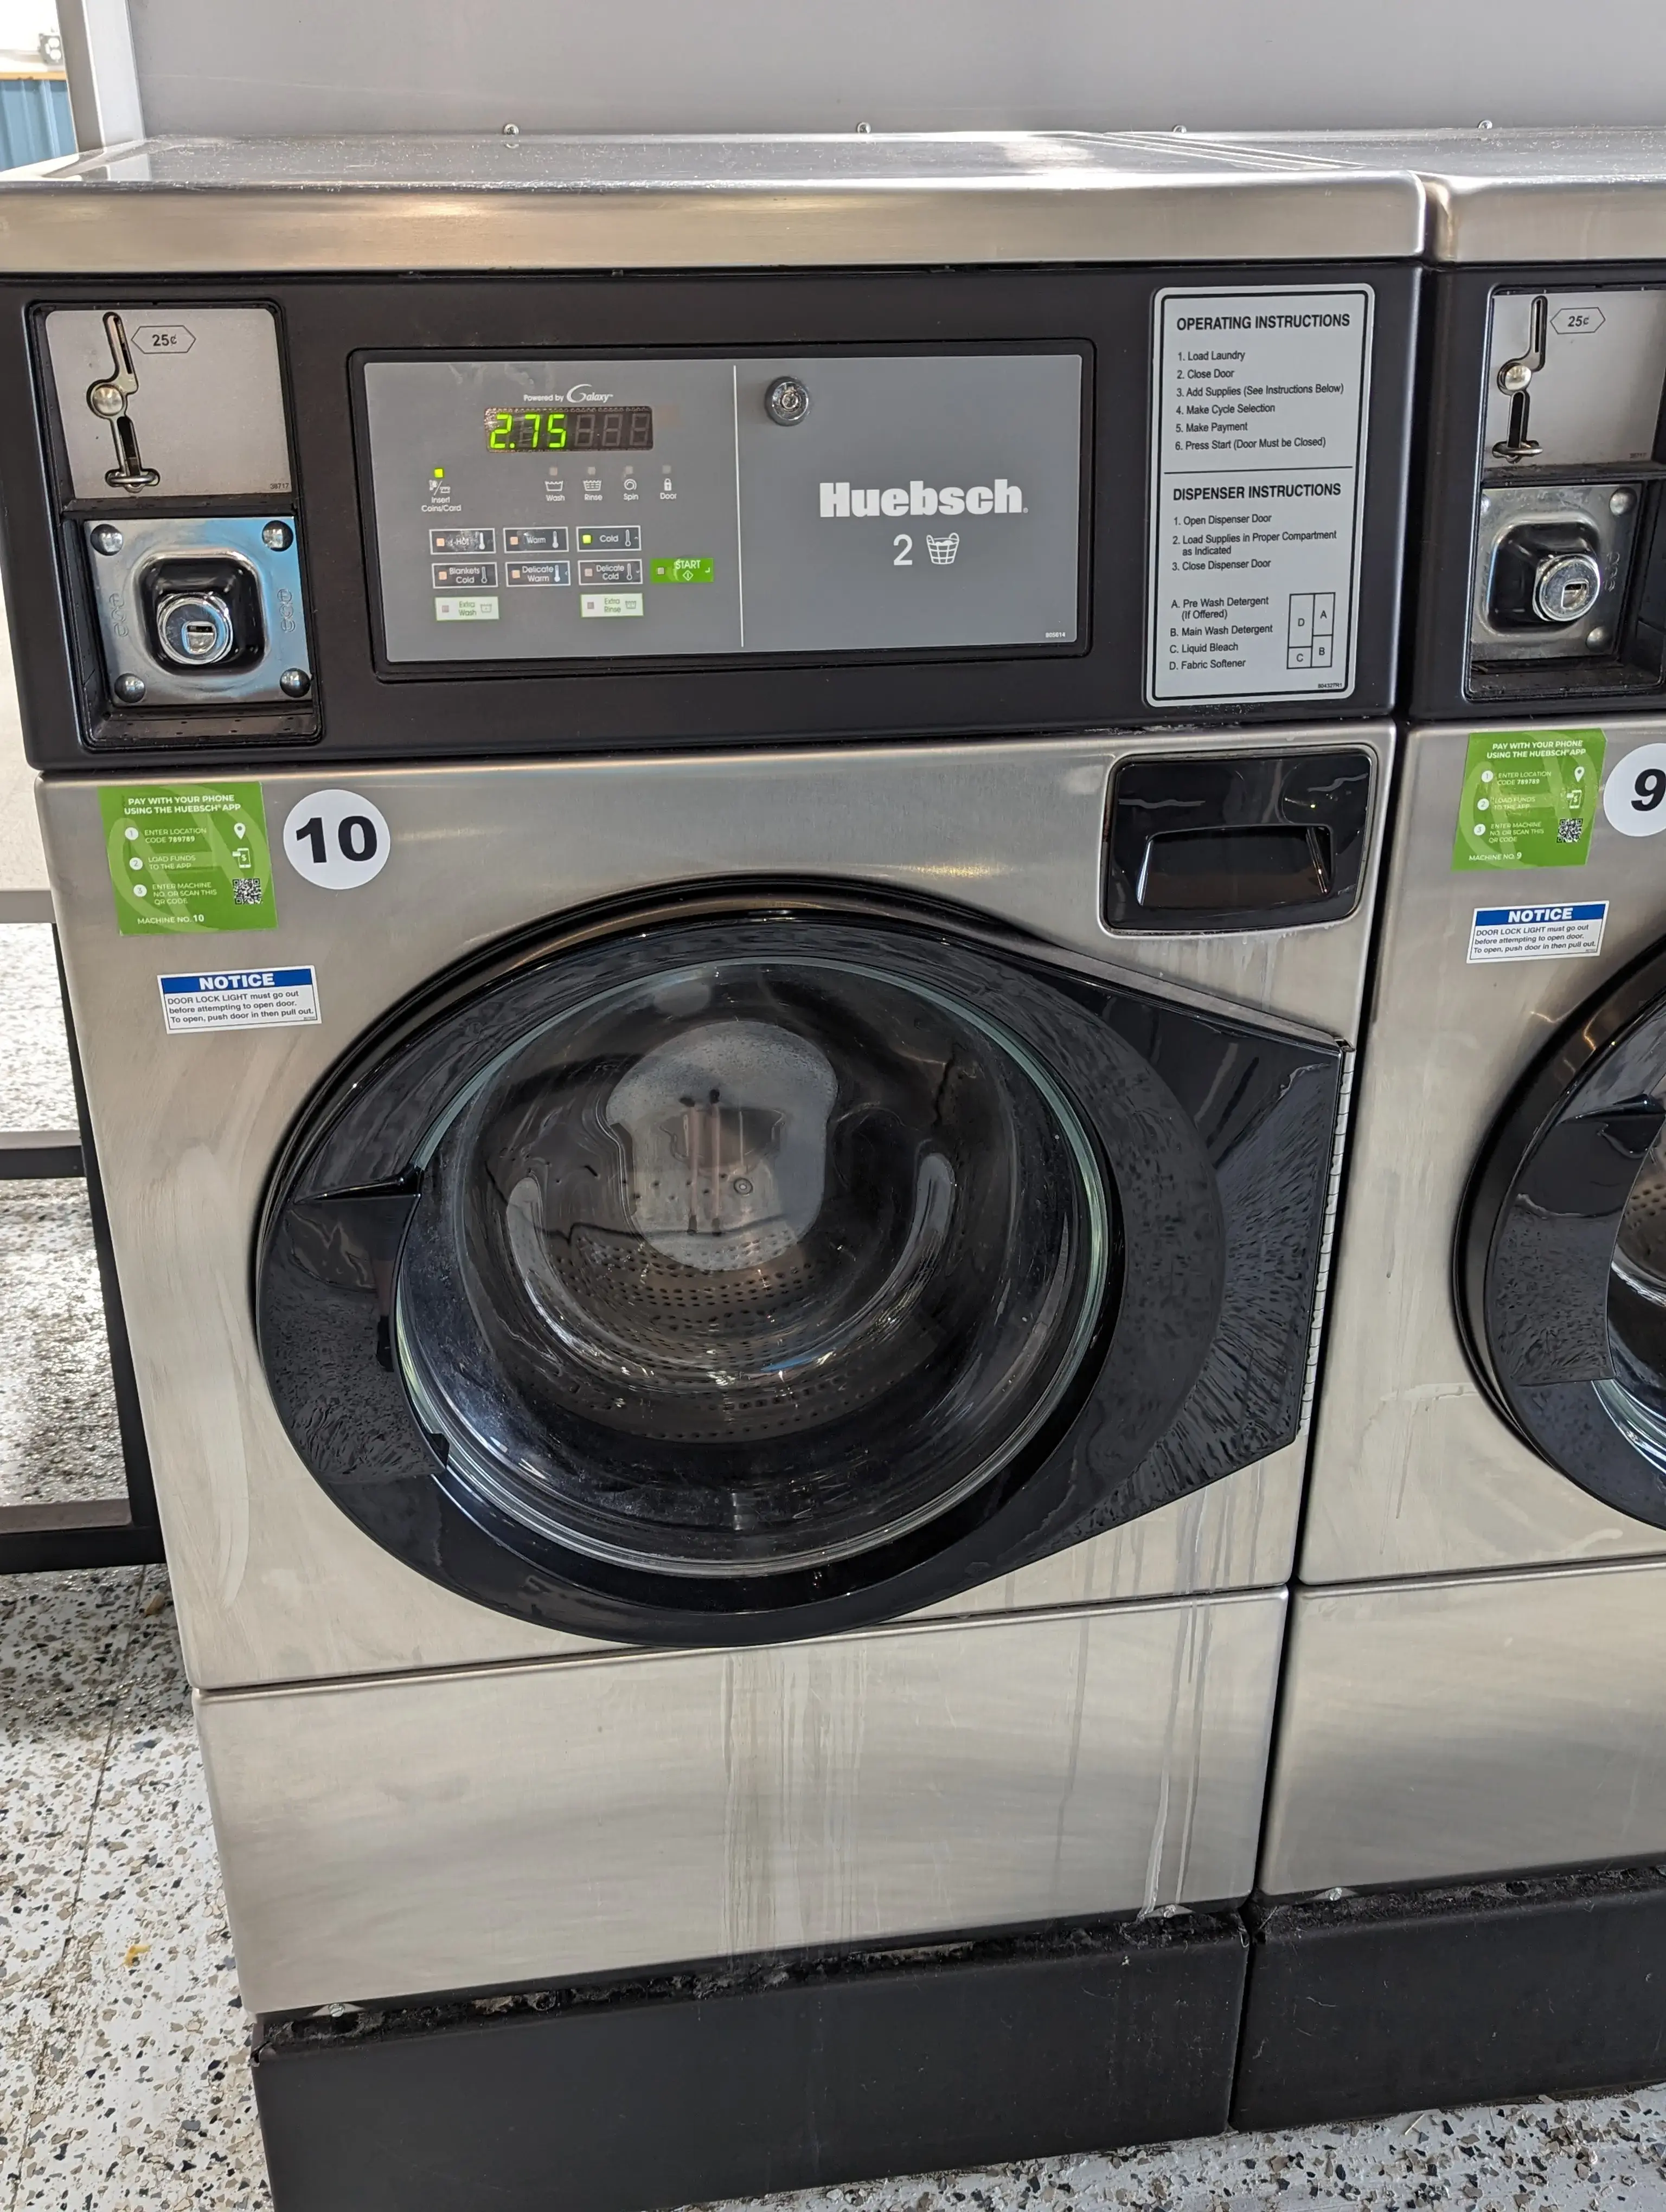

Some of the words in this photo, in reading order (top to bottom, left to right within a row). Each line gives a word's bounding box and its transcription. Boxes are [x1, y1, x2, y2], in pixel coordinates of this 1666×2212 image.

[1177, 317, 1251, 330] OPERATING
[1255, 314, 1349, 328] INSTRUCTIONS
[1178, 352, 1185, 361] 1.
[1188, 351, 1209, 361] Load
[1212, 351, 1245, 362] Laundry
[1177, 370, 1184, 379] 2.
[1188, 369, 1211, 378] Close
[1214, 369, 1234, 378] Door
[1177, 388, 1184, 397] 3.
[1186, 388, 1203, 396] Add
[1206, 387, 1241, 398] Supplies
[1244, 386, 1263, 397] (See
[1266, 384, 1313, 394] Instructions
[1316, 383, 1343, 394] Below)
[1176, 406, 1183, 415] 4.
[1187, 406, 1209, 414] Make
[1212, 404, 1234, 416] Cycle
[1238, 403, 1275, 413] Selection
[490, 413, 568, 449] 2.75
[1176, 424, 1183, 433] 5.
[1186, 423, 1208, 432] Make
[1212, 422, 1247, 433] Payment
[1175, 441, 1183, 451] 6.
[1186, 441, 1209, 450] Press
[1212, 440, 1231, 449] Start
[1234, 440, 1257, 451] (Door
[1259, 439, 1279, 447] Must
[1281, 438, 1291, 447] be
[1295, 437, 1325, 448] Closed)
[1174, 486, 1245, 500] DISPENSER
[1249, 483, 1341, 498] INSTRUCTIONS
[1174, 517, 1181, 525] 1.
[1184, 516, 1206, 527] Open
[1208, 516, 1250, 526] Dispenser
[1252, 514, 1272, 523] Door
[525, 534, 546, 543] Warm
[1172, 536, 1180, 544] 2.
[1183, 535, 1203, 544] Load
[1206, 534, 1240, 545] Supplies
[1243, 533, 1250, 542] in
[1253, 533, 1280, 543] Proper
[1282, 531, 1336, 542] Compartment
[894, 534, 912, 565] 2
[1195, 545, 1231, 555] Indicated
[674, 559, 701, 571] START
[1172, 562, 1180, 571] 3.
[1182, 562, 1206, 570] Close
[1208, 561, 1249, 570] Dispenser
[1251, 559, 1271, 568] Door
[1171, 600, 1180, 608] A.
[1183, 599, 1197, 608] Pre
[1201, 598, 1224, 607] Wash
[1227, 597, 1268, 607] Detergent
[1182, 610, 1191, 621] (If
[1193, 609, 1227, 620] Offered)
[1320, 610, 1327, 619] A
[1298, 618, 1305, 626] D
[1170, 628, 1178, 636] B.
[1182, 627, 1202, 636] Main
[1205, 626, 1228, 635] Wash
[1232, 625, 1272, 635] Detergent
[1170, 645, 1178, 653] C.
[1182, 644, 1207, 654] Liquid
[1210, 642, 1238, 651] Bleach
[1319, 647, 1325, 655] B
[1297, 653, 1303, 662] C
[1169, 661, 1178, 670] D.
[1182, 660, 1207, 669] Fabric
[1210, 659, 1246, 668] Softener
[1486, 751, 1511, 759] USING
[1631, 769, 1666, 811] 9
[127, 798, 146, 806] PAY
[148, 796, 174, 805] WITH
[175, 795, 201, 804] YOUR
[202, 794, 235, 803] PHONE
[124, 806, 153, 815] USING
[154, 805, 173, 814] THE
[223, 803, 241, 812] APP
[145, 836, 167, 844] CODE
[168, 835, 196, 844] 789789
[296, 816, 377, 863] 10
[137, 916, 175, 925] MACHINE
[193, 914, 204, 923] 10
[1508, 908, 1573, 923] NOTICE
[199, 973, 275, 990] NOTICE
[198, 1004, 241, 1012] attempting
[208, 1014, 228, 1022] push
[281, 1009, 296, 1017] pull
